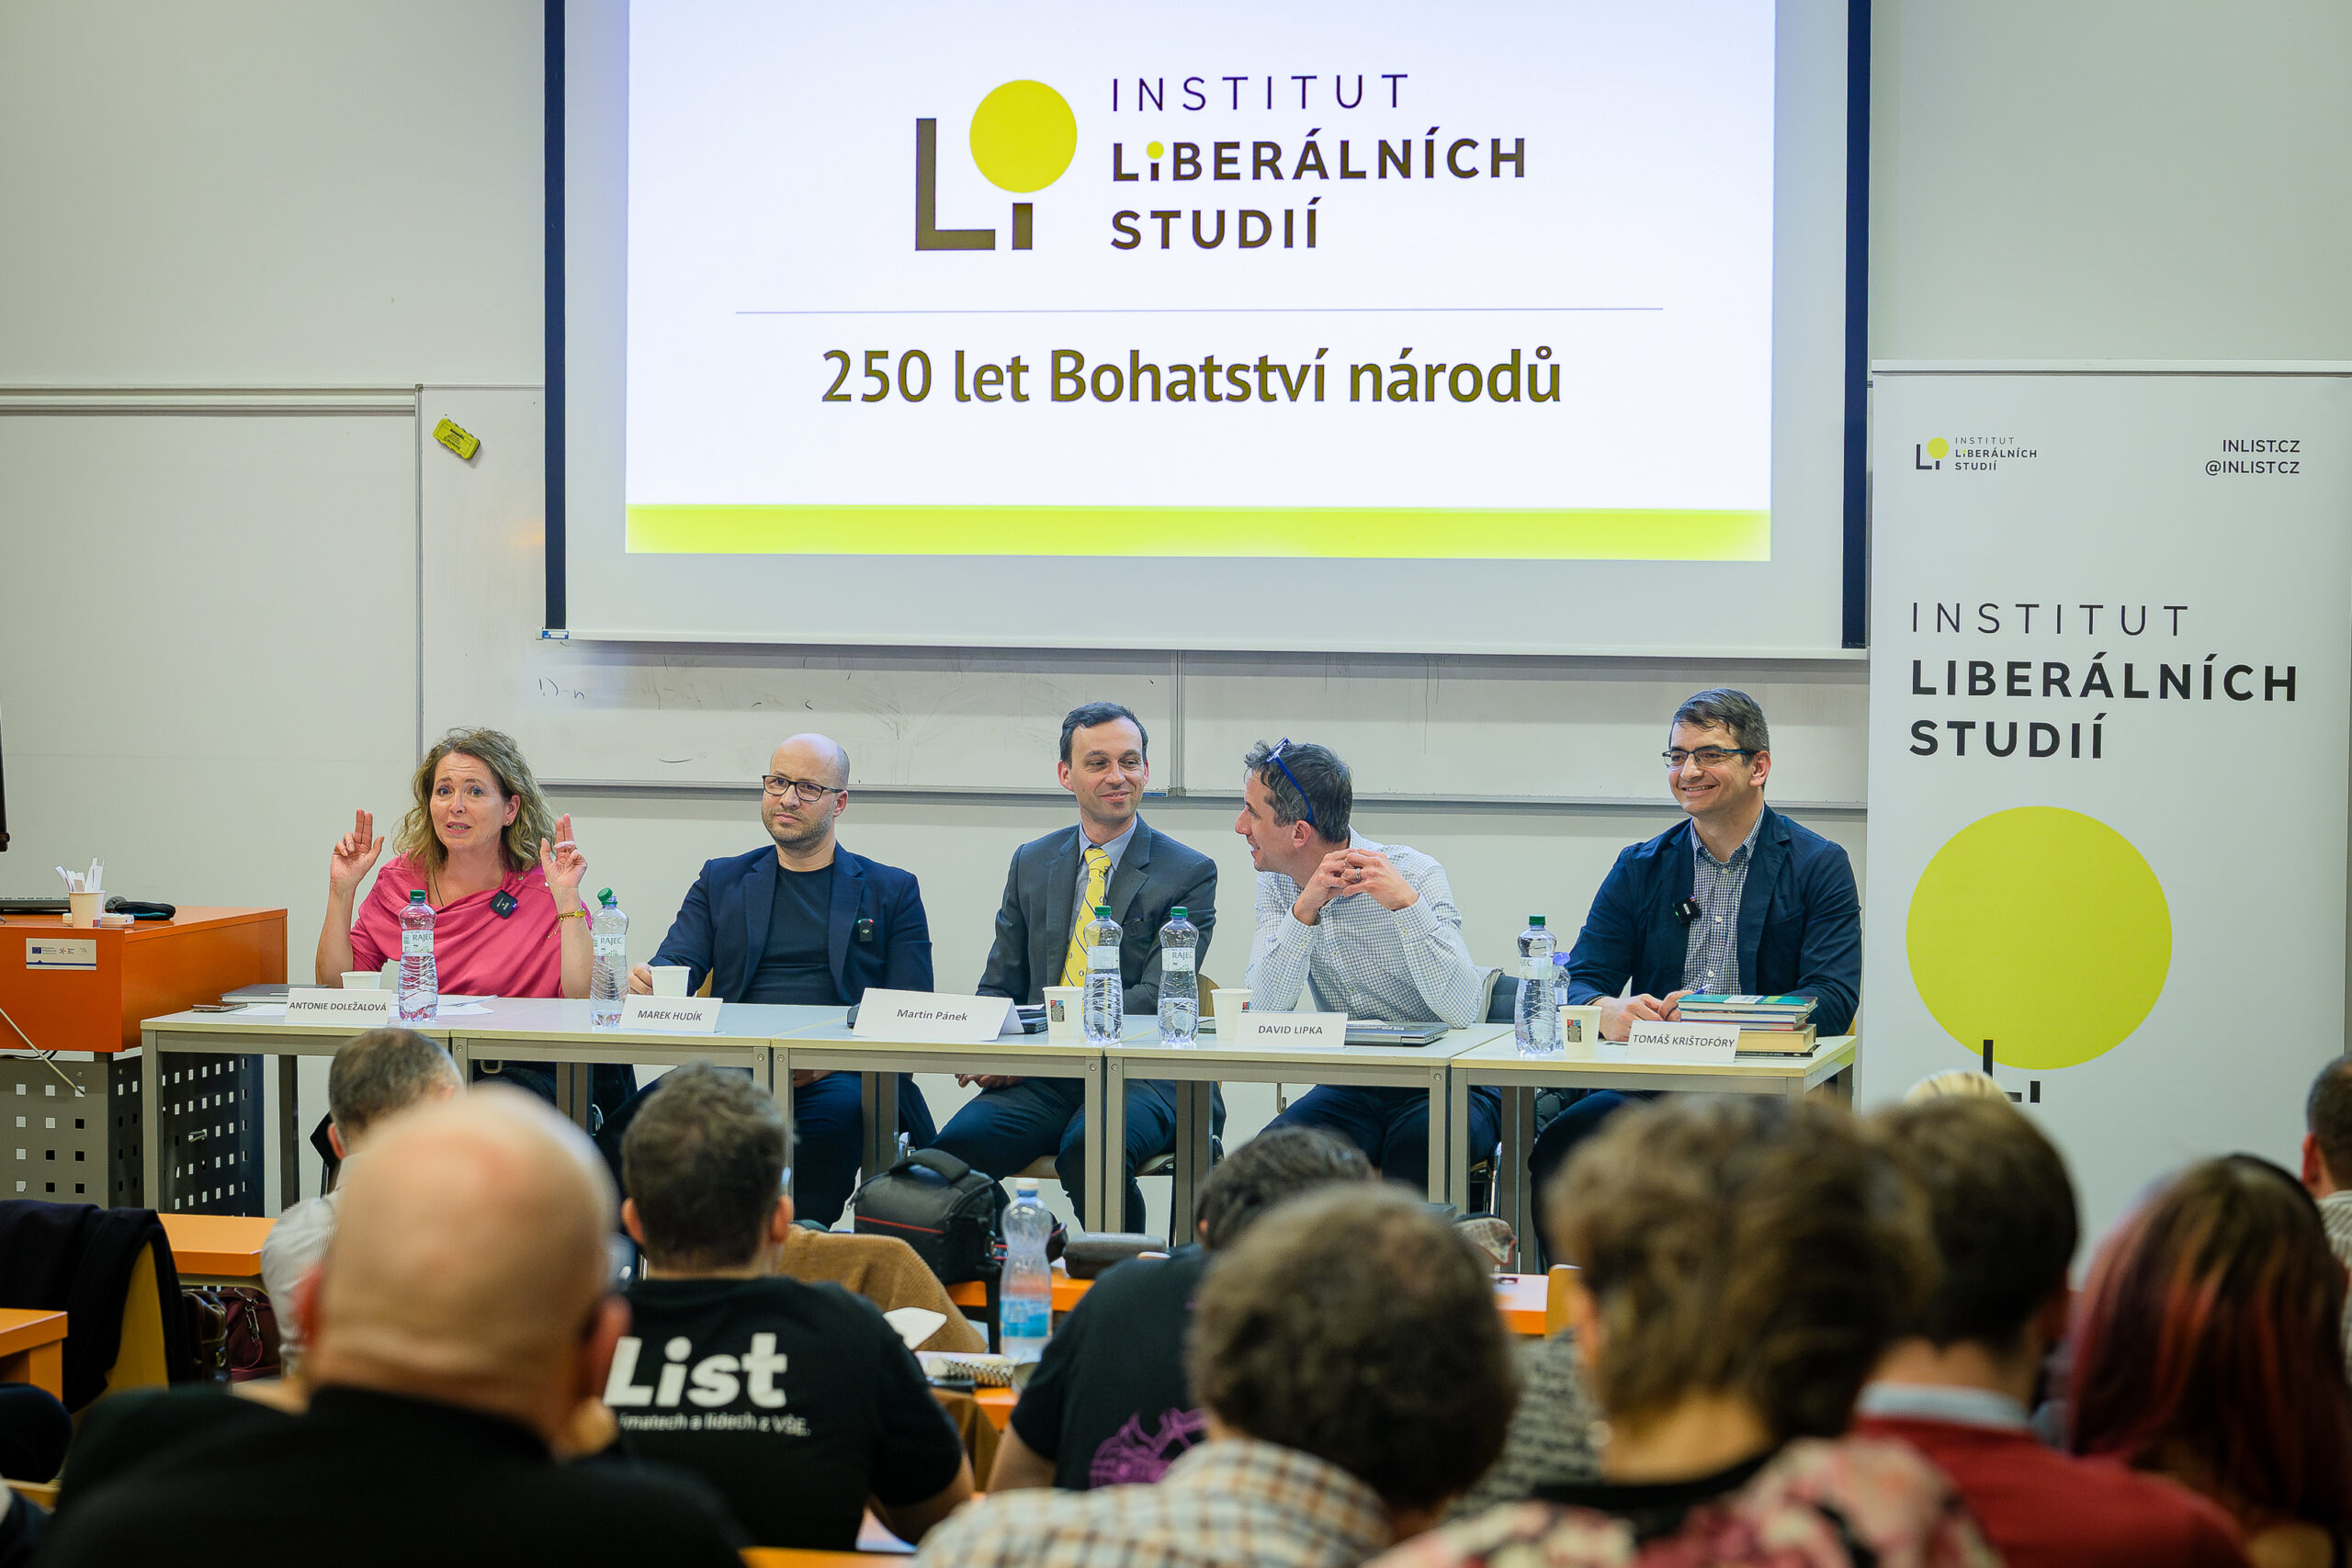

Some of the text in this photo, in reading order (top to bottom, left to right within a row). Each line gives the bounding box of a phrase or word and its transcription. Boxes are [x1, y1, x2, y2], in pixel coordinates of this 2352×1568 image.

[1114, 73, 1408, 111] INSTITUT
[1111, 197, 1322, 250] STUDIÍ
[822, 345, 1561, 403] 250 let Bohatství národů
[1955, 436, 2015, 446] INSTITUT
[2222, 439, 2301, 453] INLIST.CZ
[1955, 460, 1997, 471] STUDIÍ
[2205, 460, 2301, 476] @INLISTCZ
[1912, 602, 2188, 637] INSTITUT
[1912, 651, 2297, 702] LIBERÁLNÍCH
[1909, 712, 2108, 760] STUDIÍ
[412, 933, 434, 943] RAJEC
[600, 936, 622, 946] RAJEC
[1171, 951, 1193, 961] RAJEC
[289, 1001, 387, 1011] ANTONIE DOLEŽALOVÁ
[637, 1010, 703, 1021] MAREK HUDÍK
[897, 1009, 968, 1021] Martin Pánek
[1258, 1025, 1323, 1034] DAVID LIPKA
[1633, 1033, 1736, 1048] TOMÁŠ KRIŠTOFÓRY
[603, 1333, 788, 1408] List
